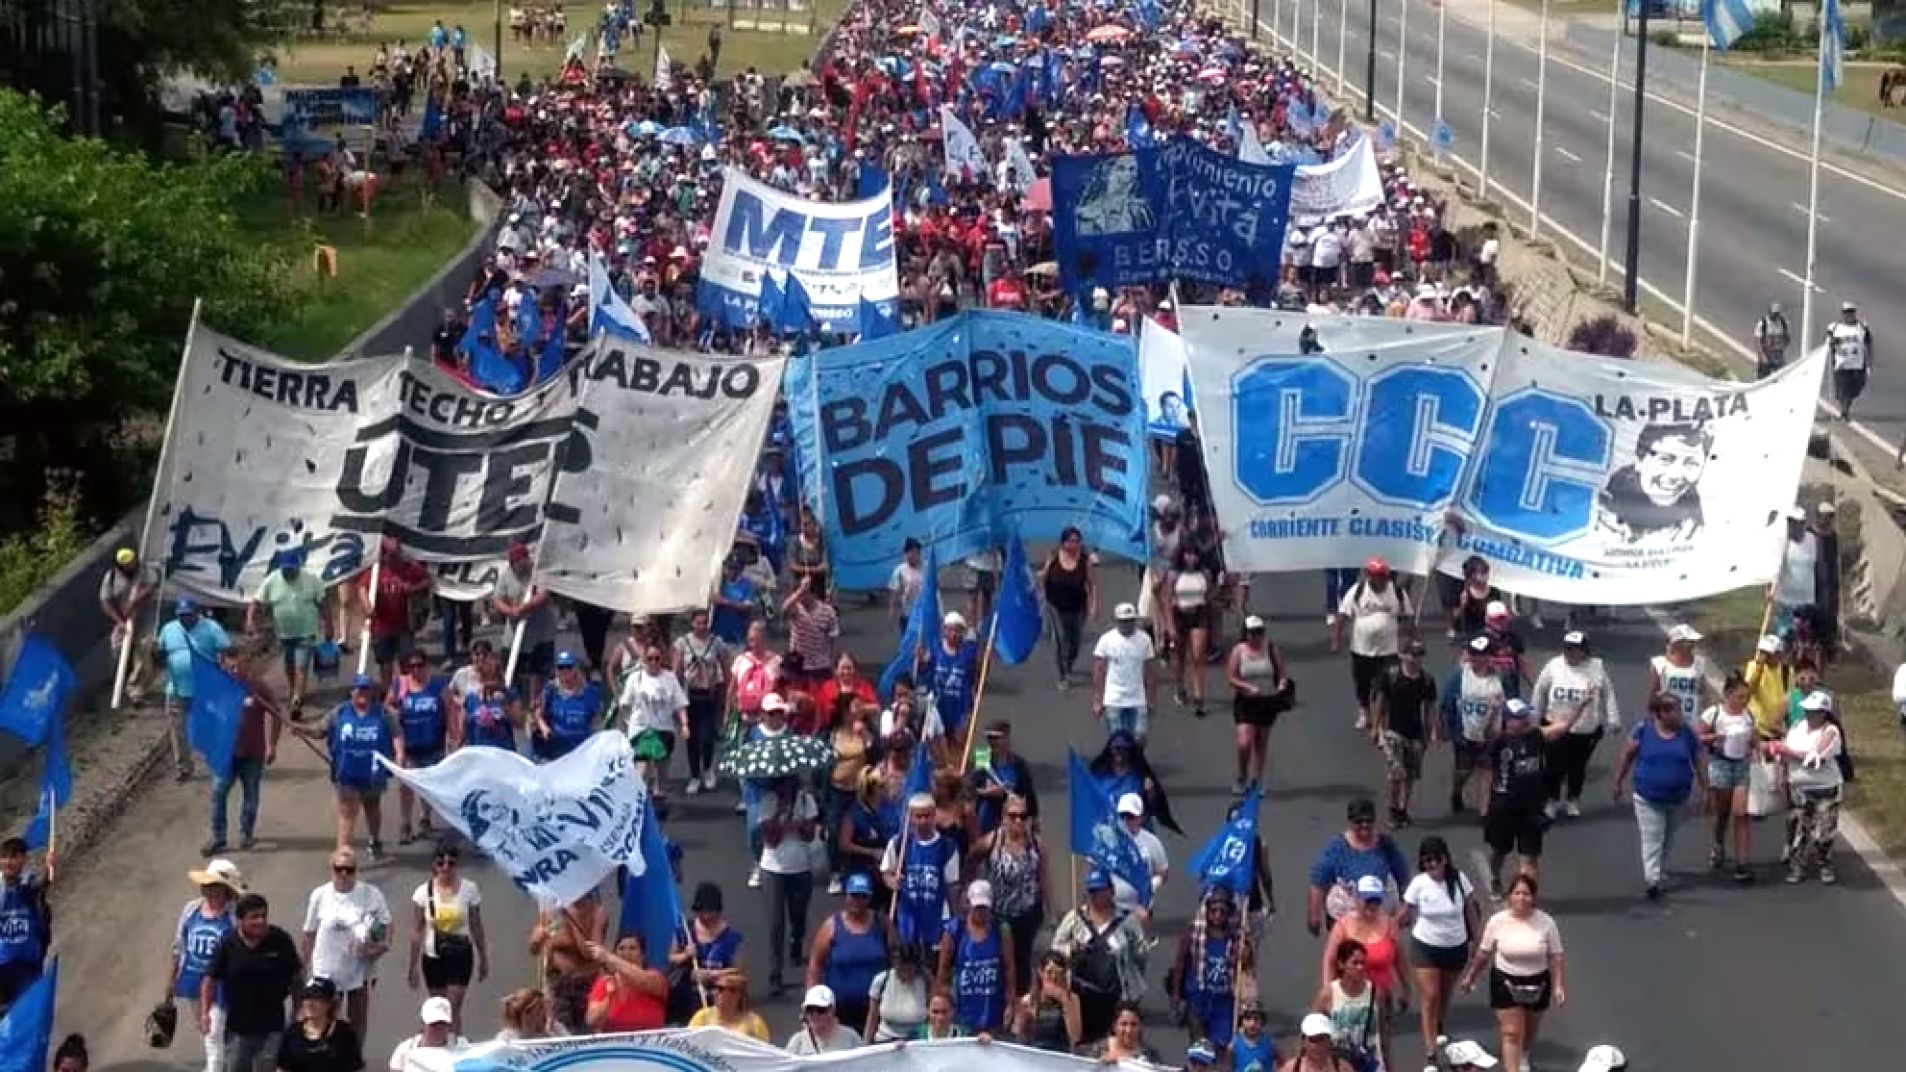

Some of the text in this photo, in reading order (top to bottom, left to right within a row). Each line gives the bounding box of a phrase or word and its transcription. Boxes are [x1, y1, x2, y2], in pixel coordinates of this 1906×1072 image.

[724, 189, 893, 271] MTE
[1114, 239, 1233, 272] BERSSO
[217, 348, 359, 413] TIERRA
[400, 370, 516, 427] TECHO
[819, 350, 1134, 453] BARRIOS
[1649, 391, 1749, 424] PLATA
[338, 429, 592, 533] UTEP
[832, 413, 1132, 537] DE PIE
[1231, 353, 1616, 545] CCC
[1250, 516, 1339, 539] CORRIENTE
[1350, 516, 1436, 545] CLASIST
[437, 561, 499, 584] PLA
